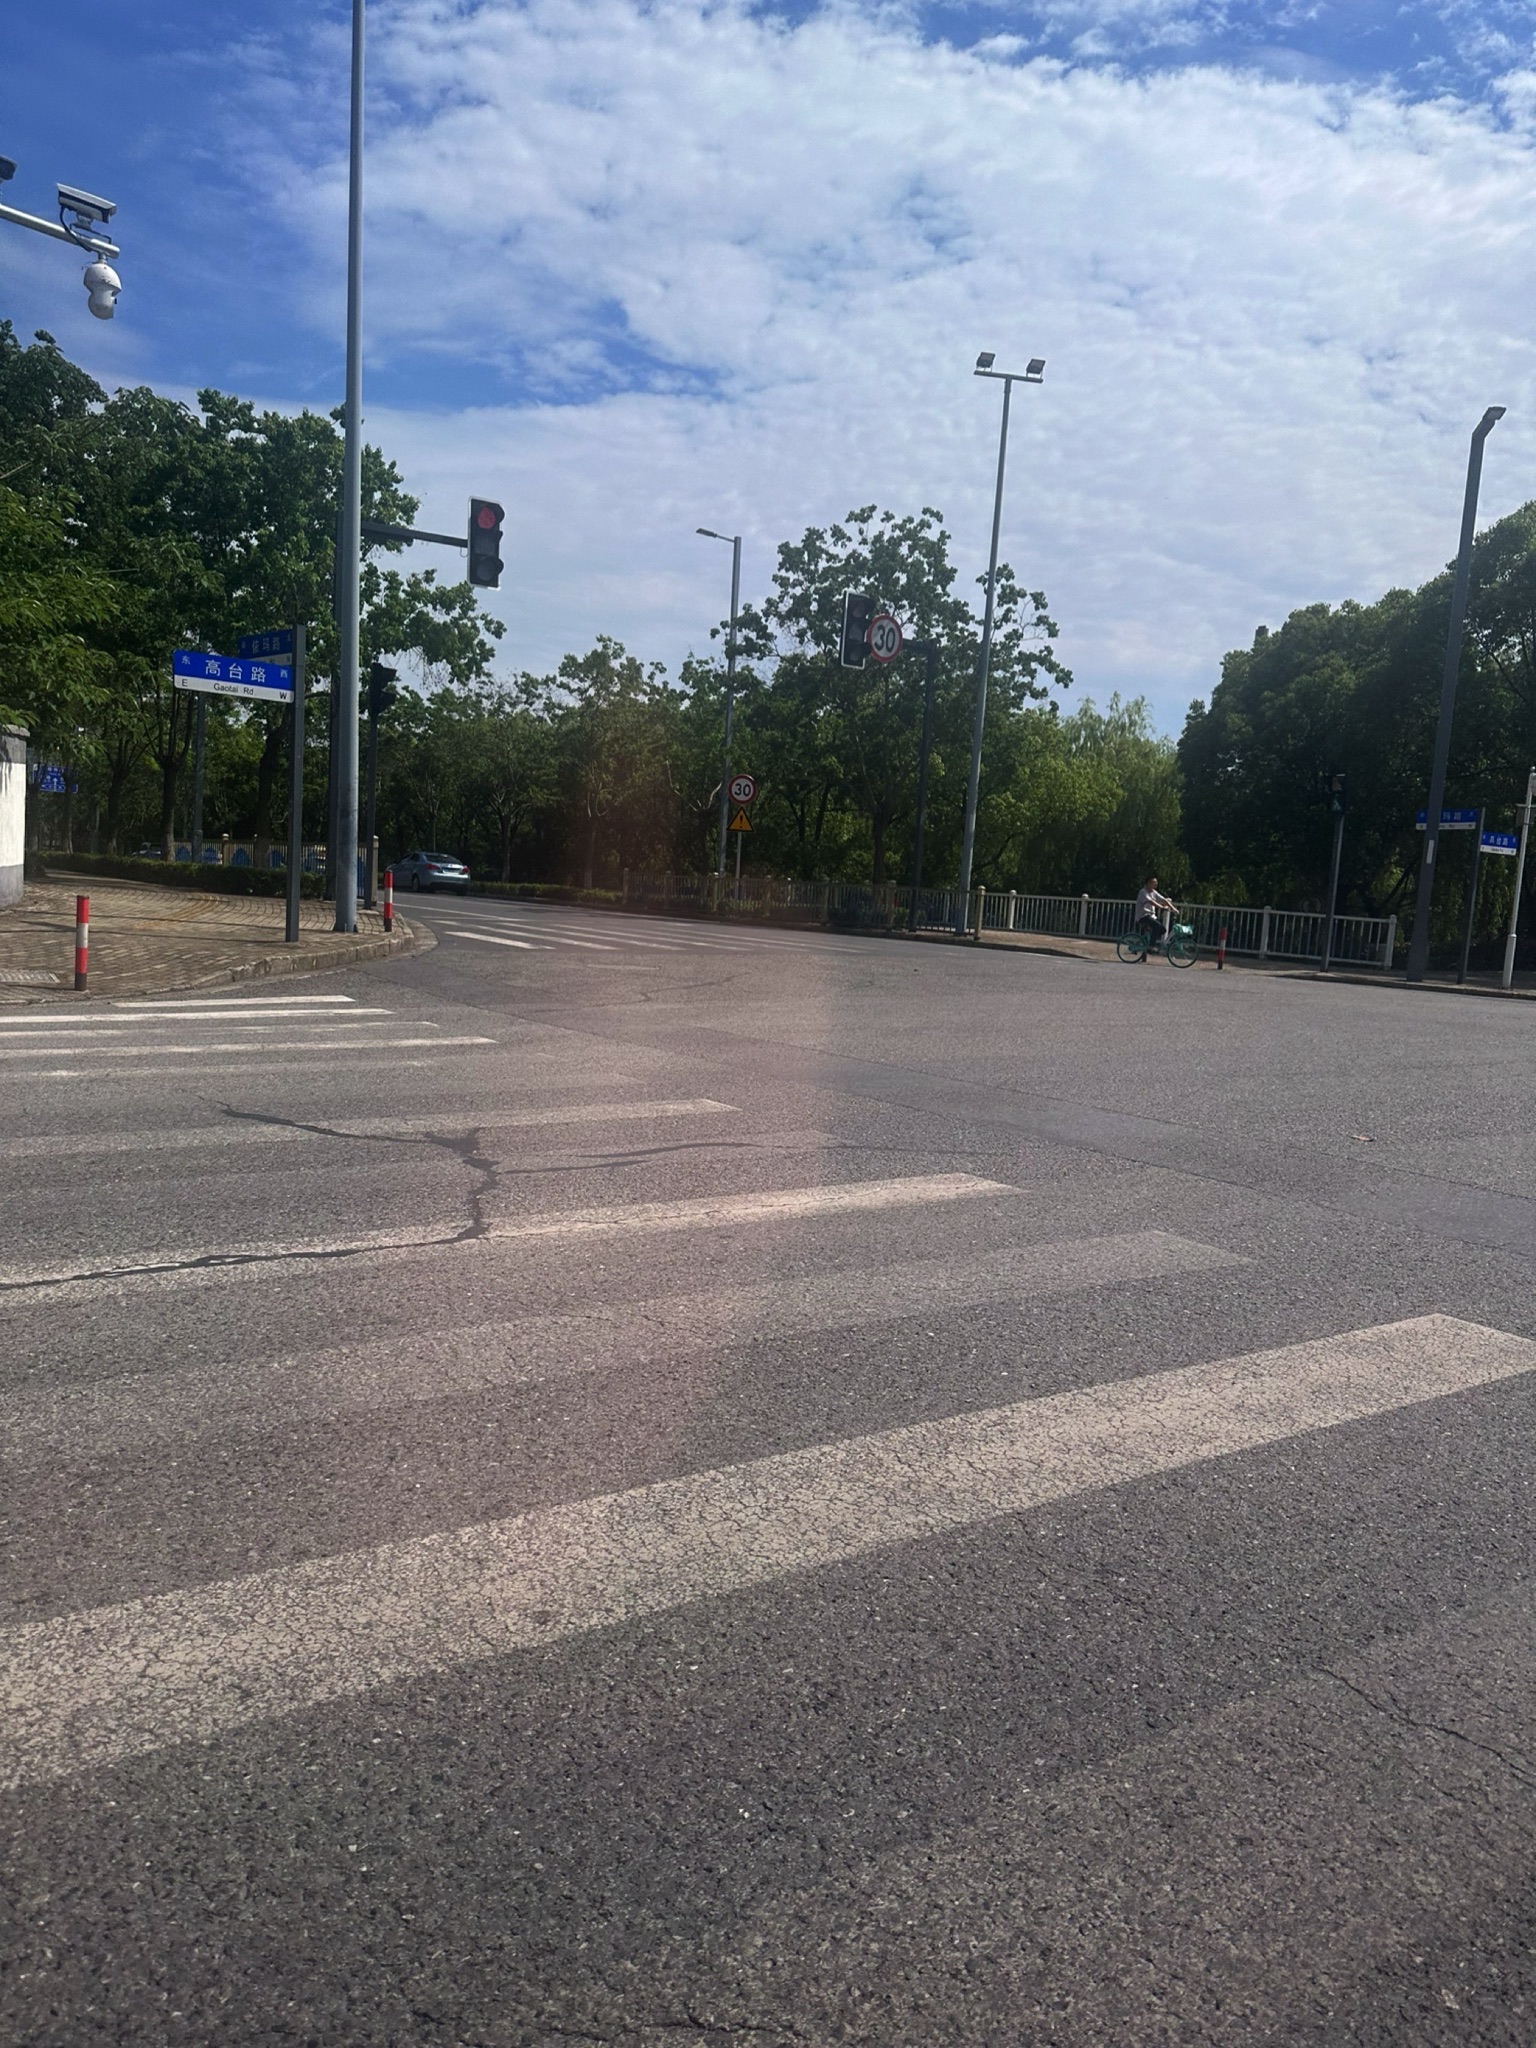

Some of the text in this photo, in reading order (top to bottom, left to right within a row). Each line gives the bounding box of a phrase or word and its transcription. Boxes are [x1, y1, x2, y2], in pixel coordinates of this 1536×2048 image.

[875, 625, 896, 653] 30
[181, 655, 190, 665] 东
[205, 660, 266, 683] 高台路
[280, 669, 288, 678] 西
[182, 678, 188, 687] E
[213, 683, 238, 693] Gaotai
[280, 692, 287, 700] W
[734, 783, 751, 797] 30
